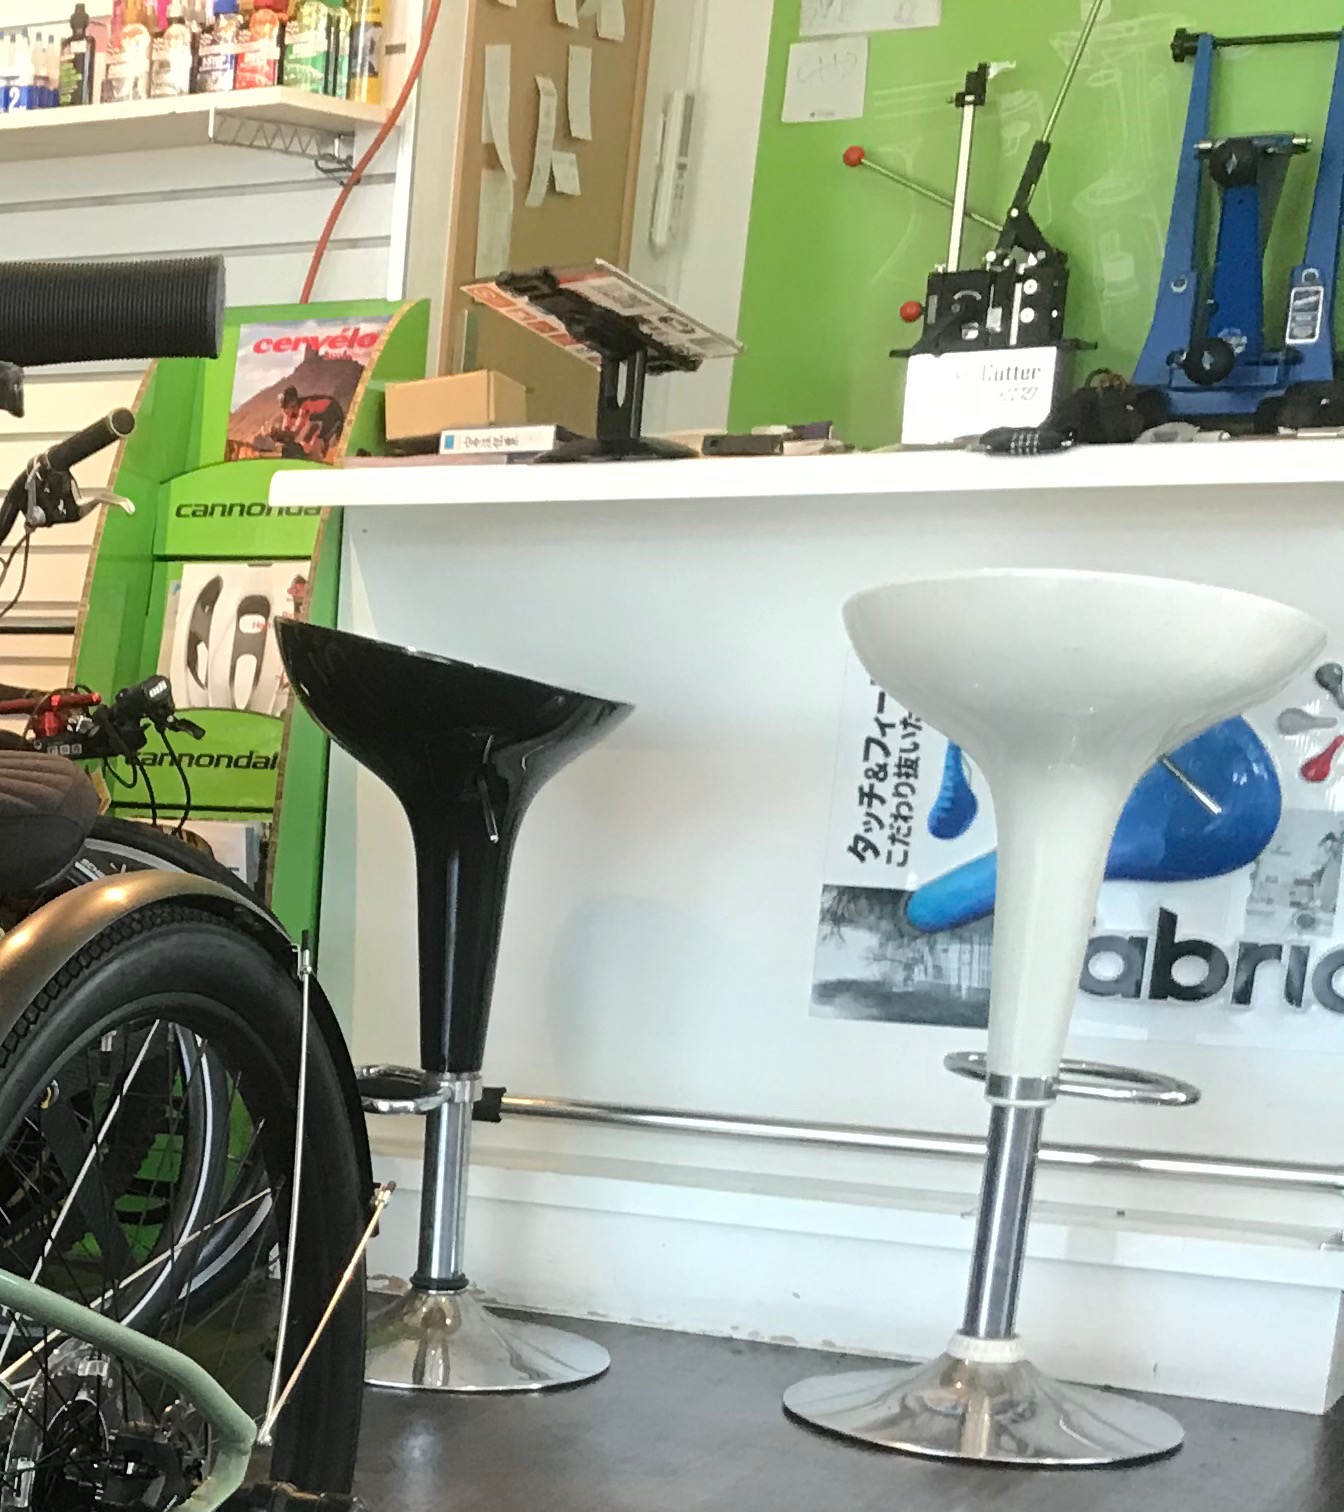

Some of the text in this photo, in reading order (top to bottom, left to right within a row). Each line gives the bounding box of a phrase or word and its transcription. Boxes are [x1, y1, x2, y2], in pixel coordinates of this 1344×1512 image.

[253, 327, 379, 354] cervélo
[847, 678, 896, 864] タッチ&フィー
[1079, 906, 1344, 1009] abric
